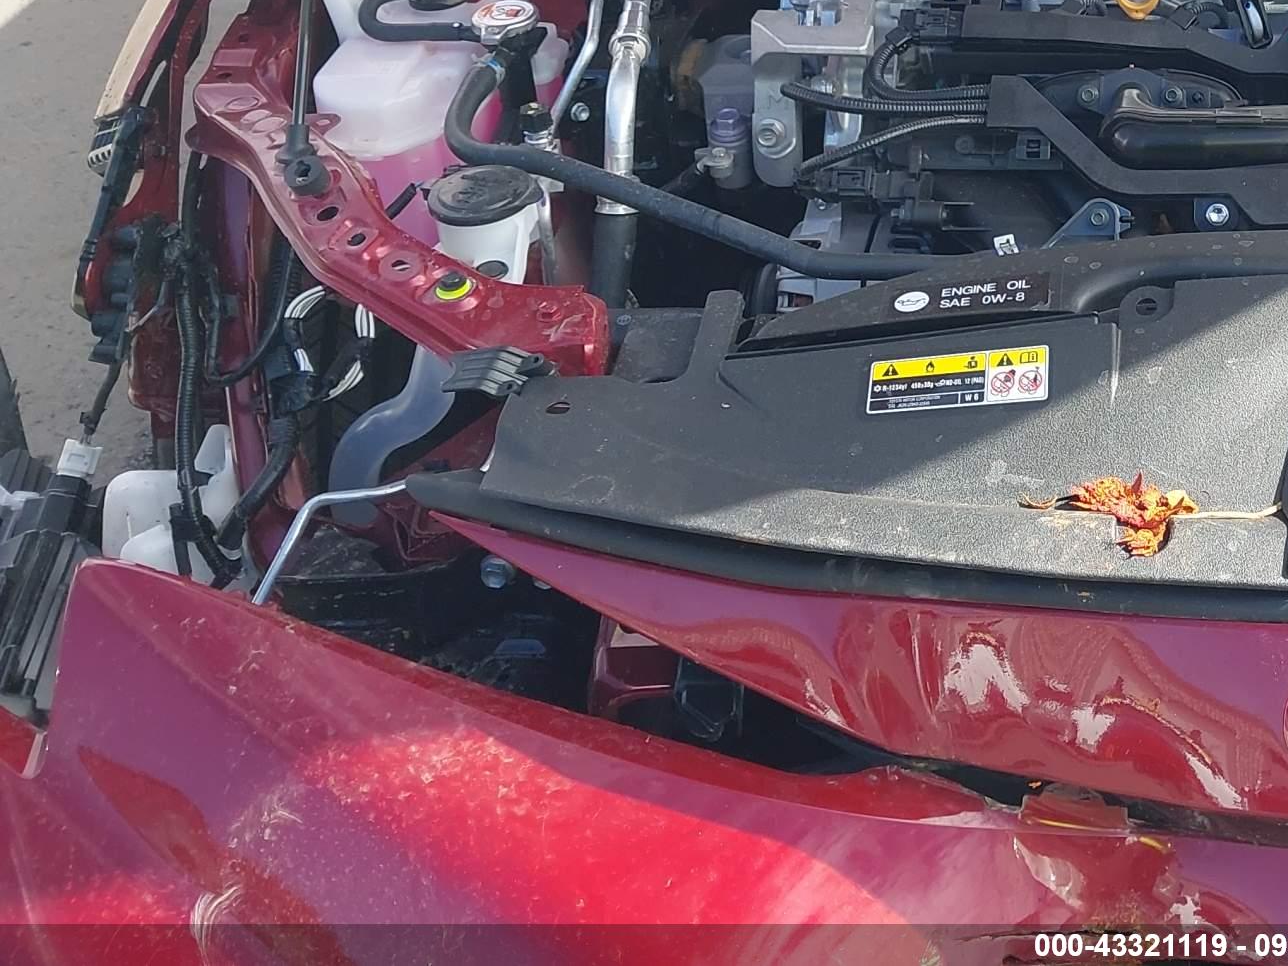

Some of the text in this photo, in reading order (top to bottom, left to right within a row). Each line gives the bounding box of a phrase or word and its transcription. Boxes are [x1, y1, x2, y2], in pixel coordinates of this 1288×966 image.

[941, 279, 1031, 298] ENGINE OIL
[939, 291, 1025, 308] SAE 0W-8
[964, 393, 972, 402] W
